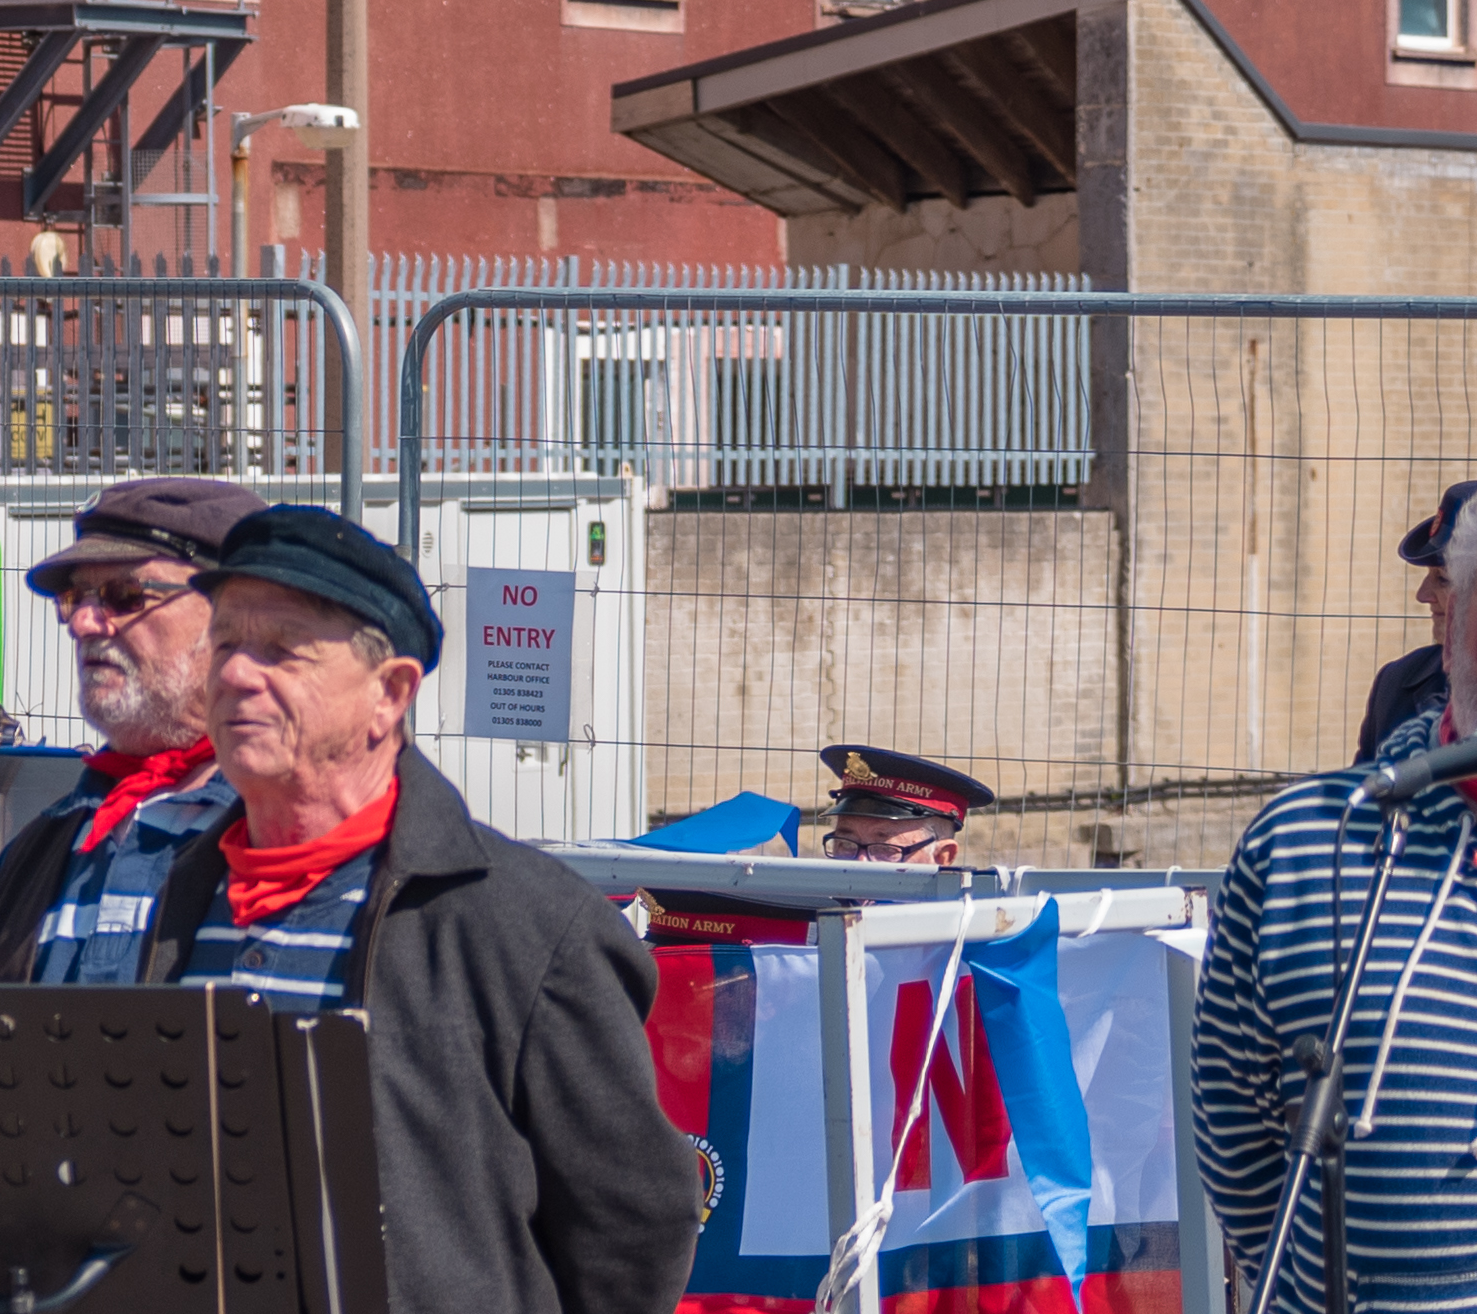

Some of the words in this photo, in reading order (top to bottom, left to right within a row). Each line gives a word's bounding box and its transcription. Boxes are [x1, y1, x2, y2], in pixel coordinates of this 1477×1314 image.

[503, 585, 538, 606] NO
[483, 626, 555, 649] ENTRY
[488, 660, 513, 669] PLEASE
[515, 662, 549, 671] CONTACT
[487, 673, 523, 683] HARBOUR
[526, 675, 549, 684] OFFICE
[493, 688, 515, 696] 01305
[517, 689, 543, 698] 838423
[490, 702, 506, 711] OUT
[508, 703, 517, 711] OF
[519, 704, 545, 713] HOURS
[492, 717, 514, 725] 01305
[516, 718, 542, 727] 838000
[896, 781, 933, 798] ARMY
[692, 920, 735, 934] ARMY
